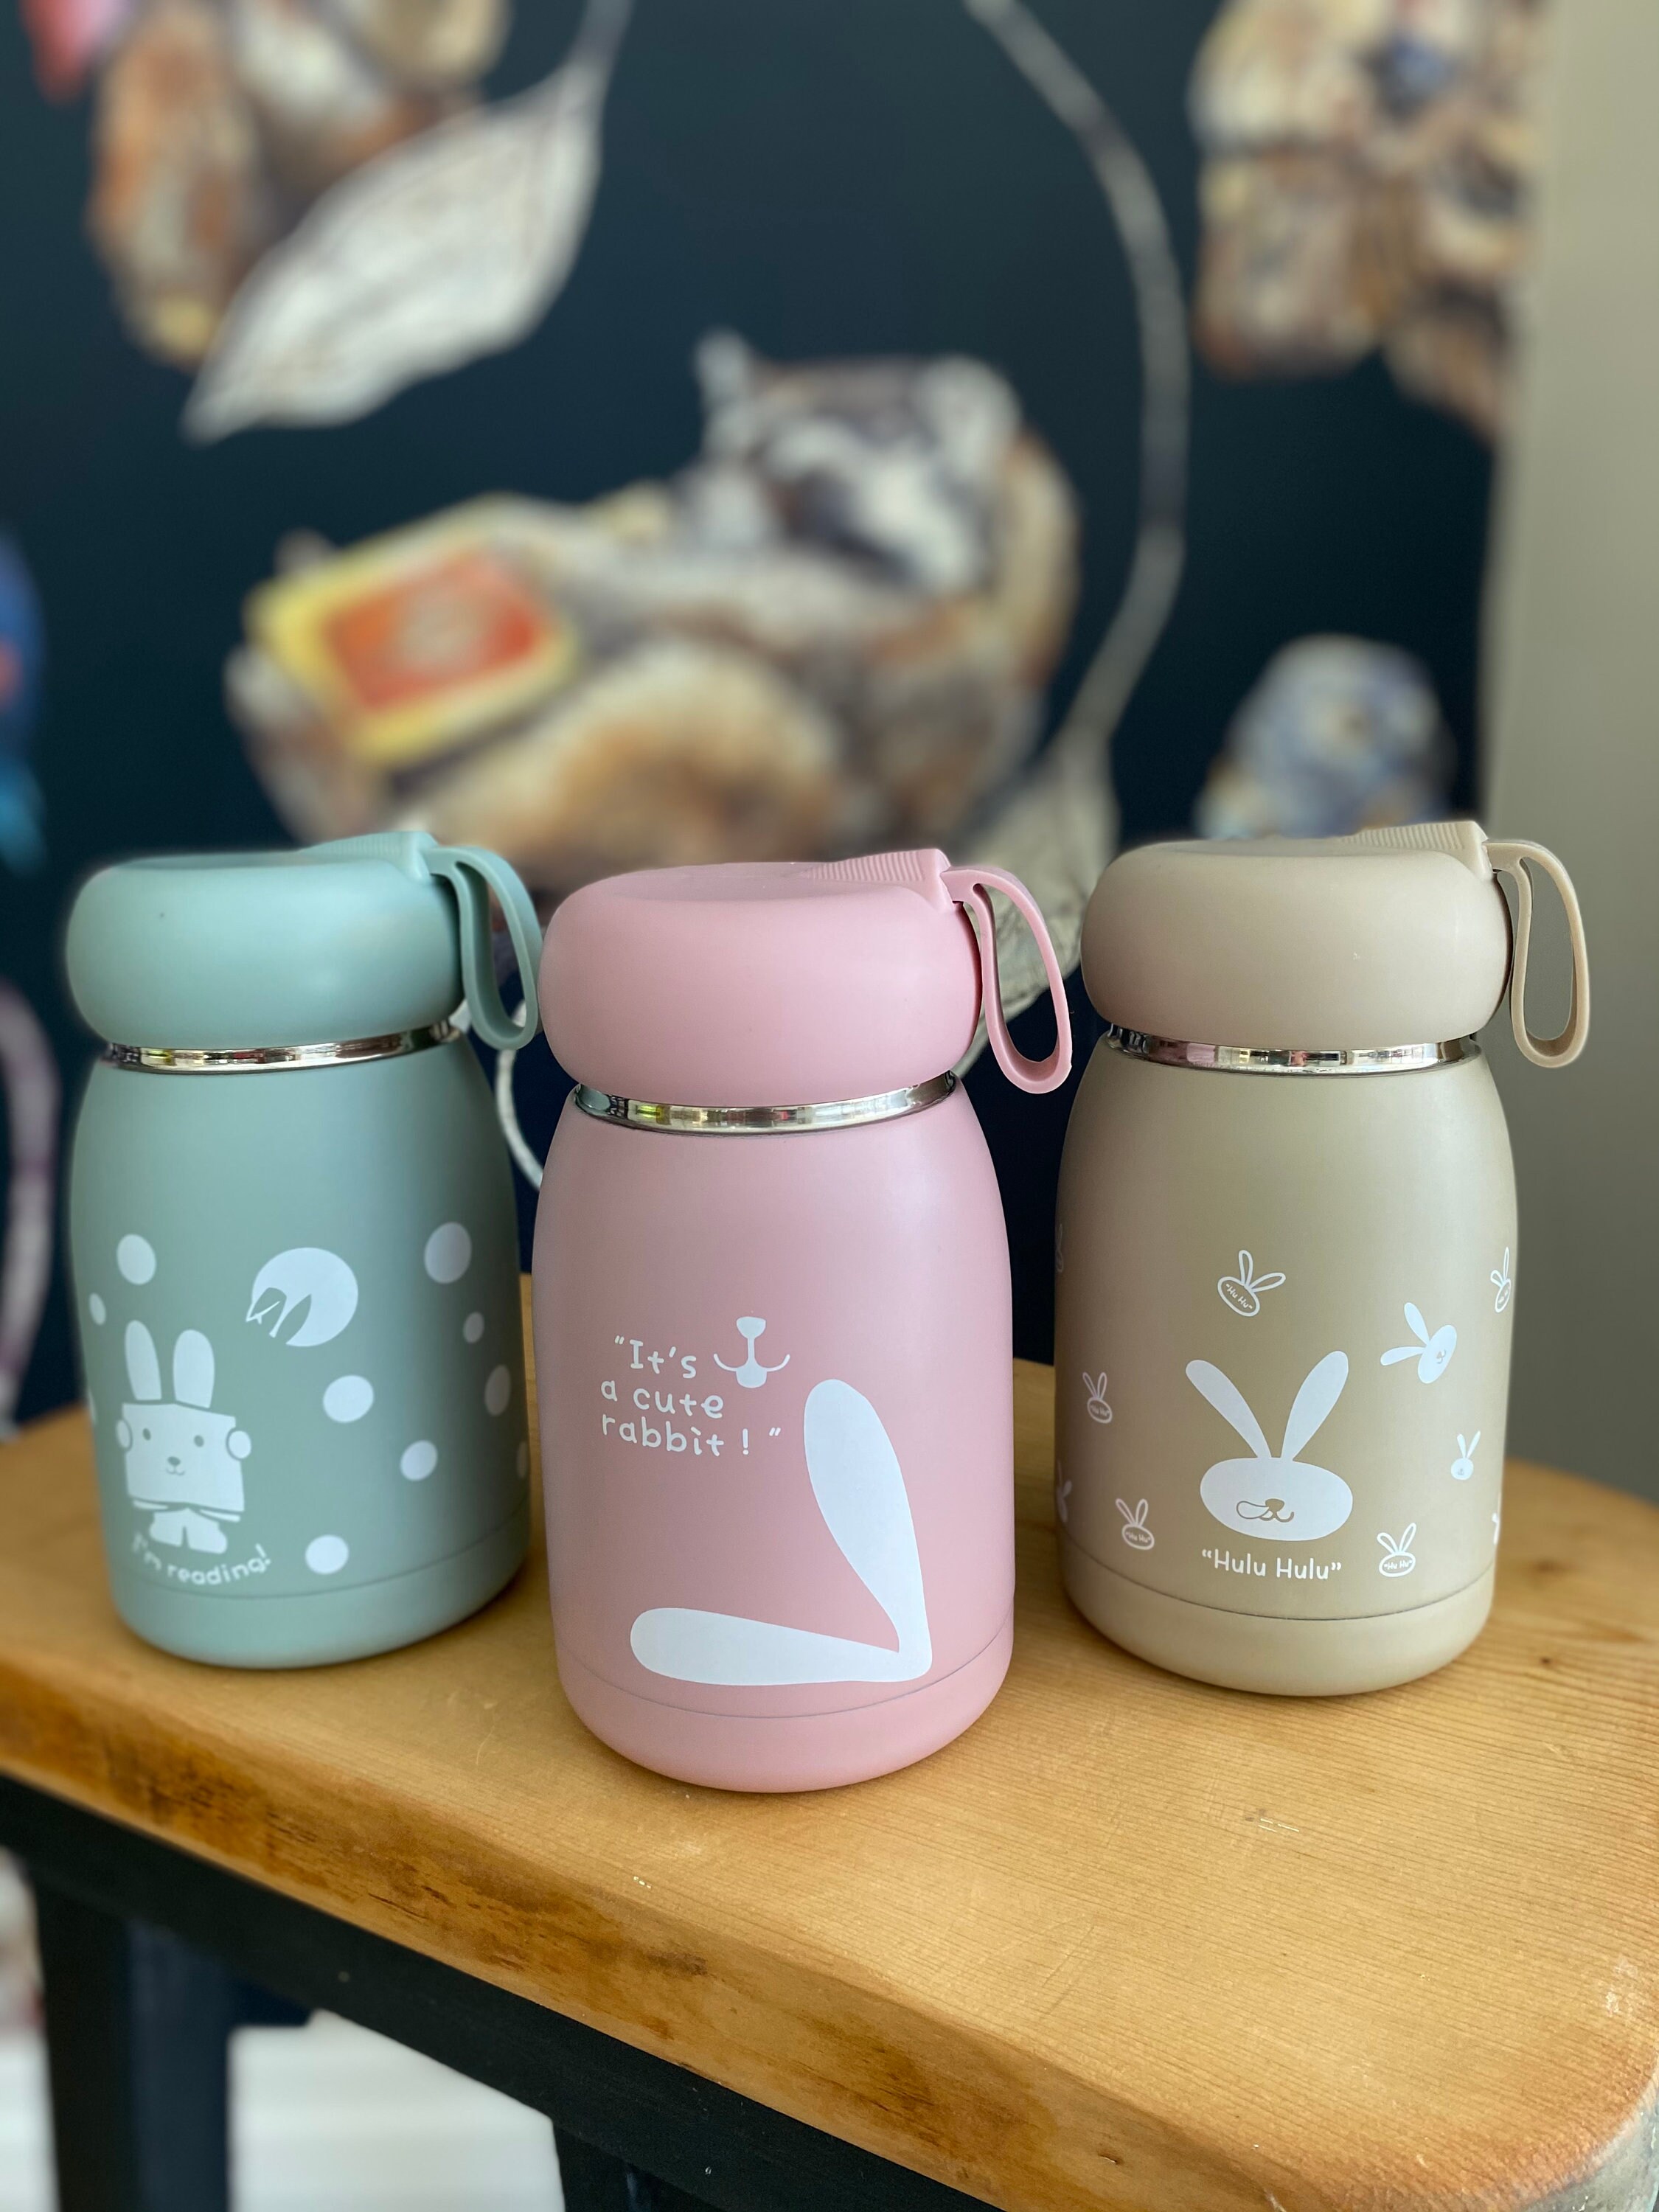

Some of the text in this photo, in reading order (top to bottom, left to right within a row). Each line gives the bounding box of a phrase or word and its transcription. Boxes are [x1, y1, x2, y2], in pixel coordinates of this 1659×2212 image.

[601, 1380, 724, 1419] a cute
[167, 1543, 271, 1585] reading!
